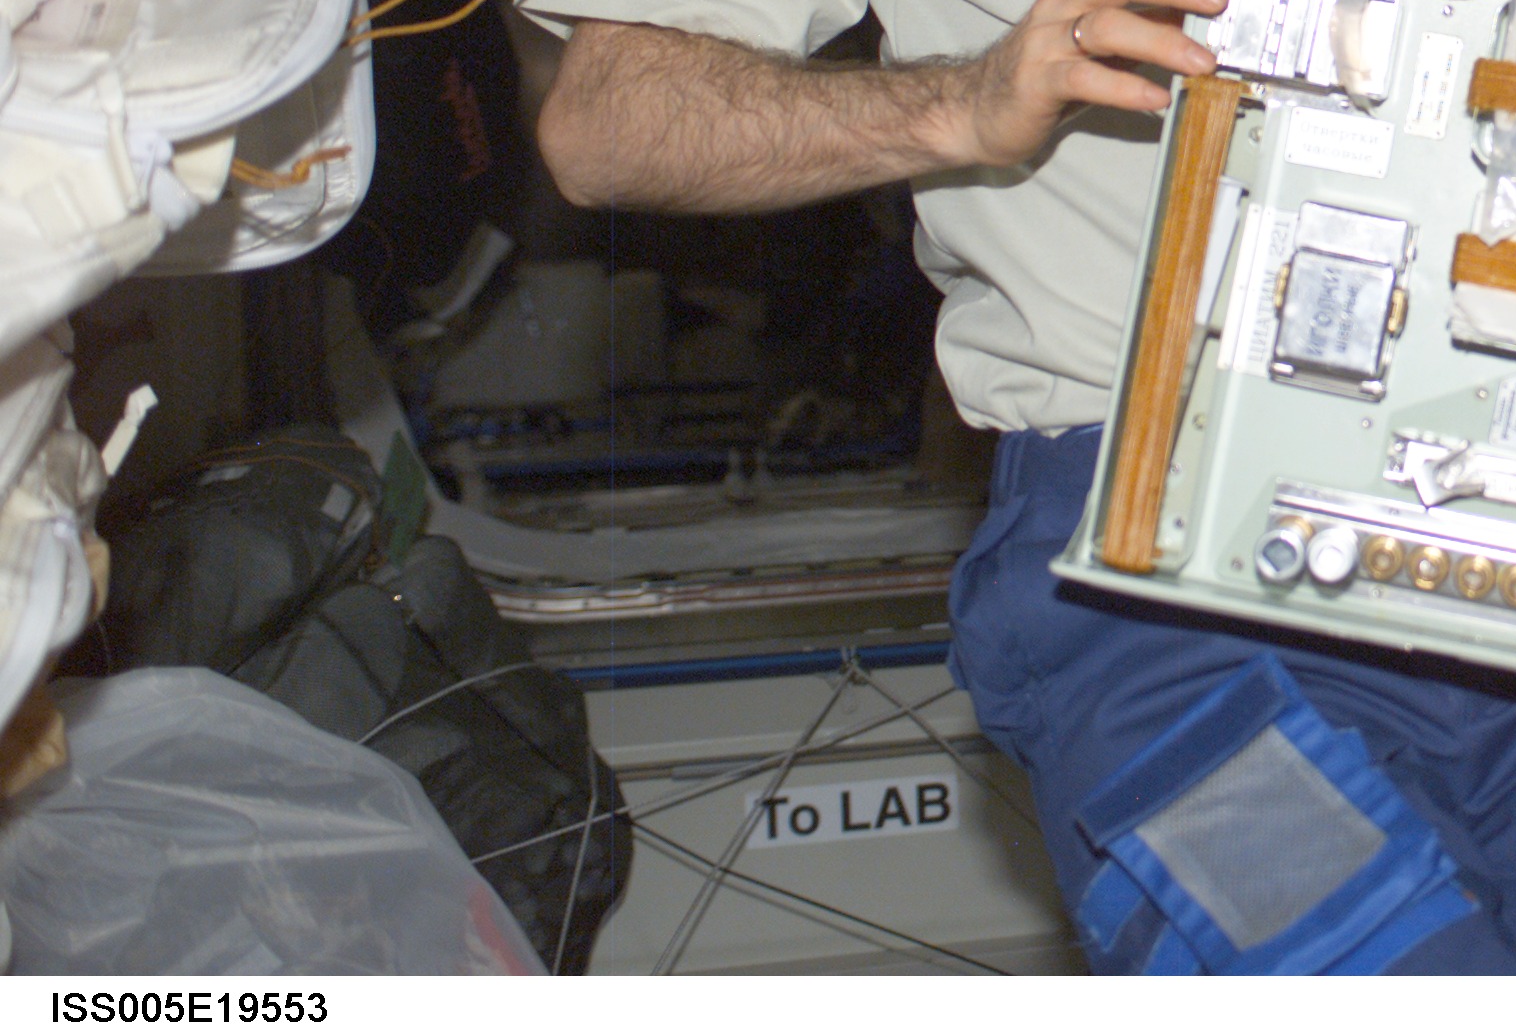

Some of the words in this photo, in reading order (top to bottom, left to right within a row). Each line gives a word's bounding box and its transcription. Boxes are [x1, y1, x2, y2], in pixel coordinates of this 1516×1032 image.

[1246, 268, 1279, 363] ЦИАТИМ
[1268, 218, 1290, 258] 221
[760, 796, 821, 840] To
[841, 782, 952, 833] LAB
